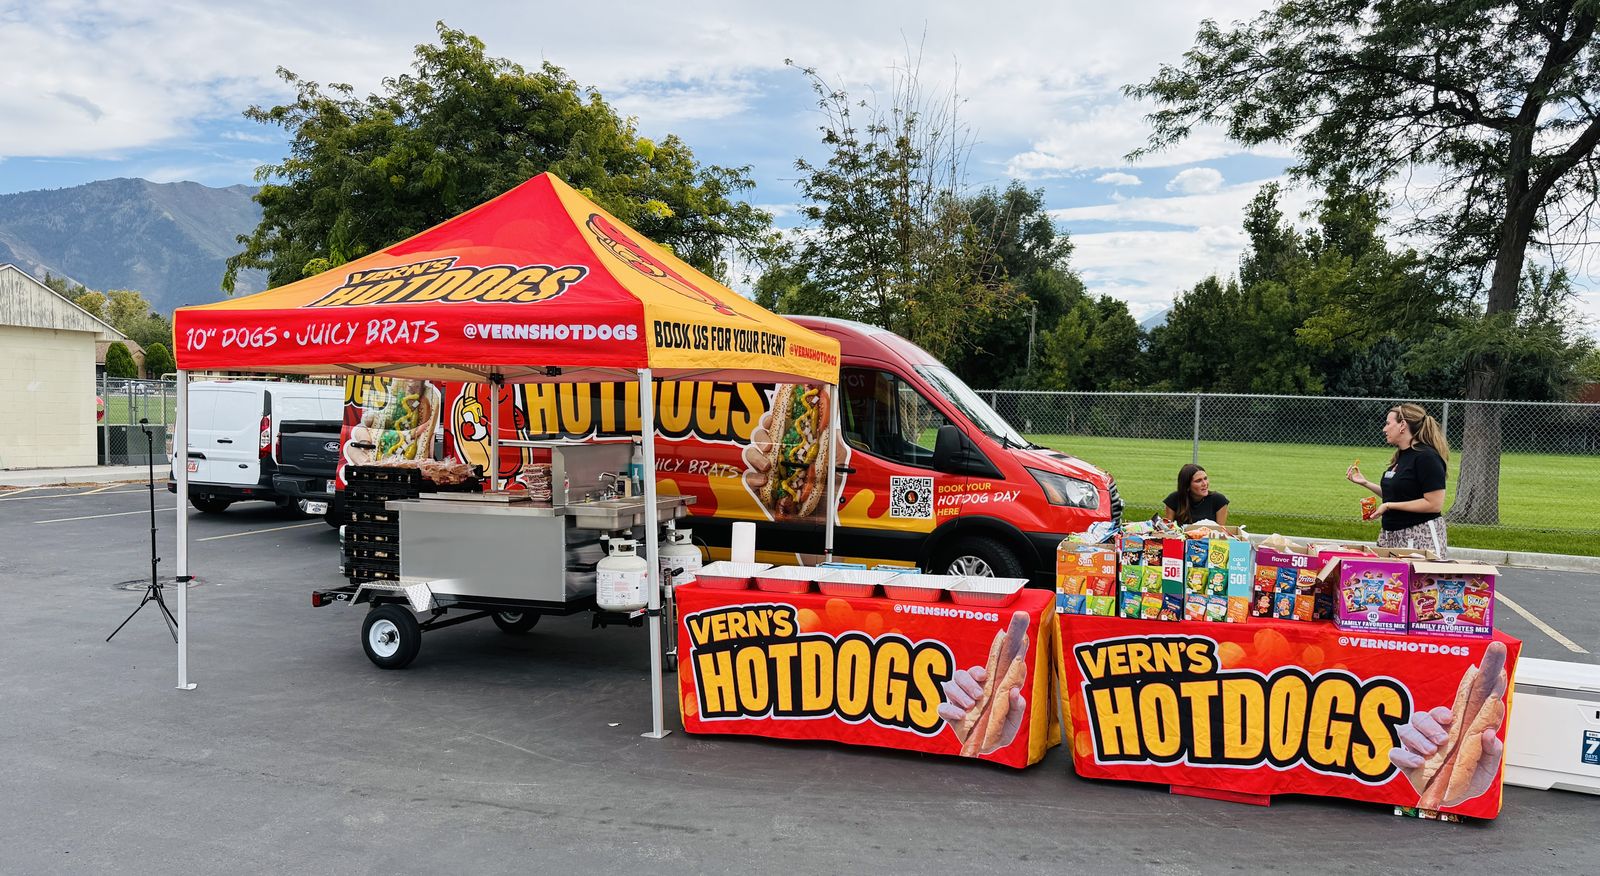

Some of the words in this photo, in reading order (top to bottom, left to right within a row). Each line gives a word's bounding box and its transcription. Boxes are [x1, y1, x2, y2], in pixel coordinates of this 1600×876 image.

[349, 257, 452, 285] VERN'S
[317, 266, 582, 305] HOTDOGS
[222, 326, 277, 348] DOGS
[296, 321, 359, 346] JUICY
[366, 318, 439, 345] BRATS
[463, 323, 638, 340] @VERNSHOTDOGS
[653, 320, 691, 349] BOOK
[692, 325, 708, 350] US
[711, 326, 731, 352] FOR
[734, 329, 759, 354] YOUR
[761, 332, 786, 357] EVENT
[789, 343, 837, 367] @VERNSHOTDOGS
[688, 459, 739, 479] BRATS
[938, 484, 964, 493] BOOK
[966, 482, 991, 492] YOUR
[937, 493, 989, 506] HOTDOG
[993, 490, 1021, 502] DAY
[937, 507, 960, 516] HERE
[1102, 566, 1110, 574] 30
[1291, 555, 1304, 567] 50
[1164, 567, 1177, 578] 50
[1230, 574, 1243, 584] 50
[893, 604, 999, 623] @VERNSHOTDOGS
[689, 609, 794, 646] VERN'S
[1438, 624, 1474, 632] FAVORITES
[1337, 635, 1470, 656] @VERNSHOTDOGS
[1079, 641, 1214, 680] VERN'S
[697, 638, 947, 729] HOTDOGS
[1091, 675, 1403, 777] HOTDOGS
[1586, 739, 1600, 755] 7
